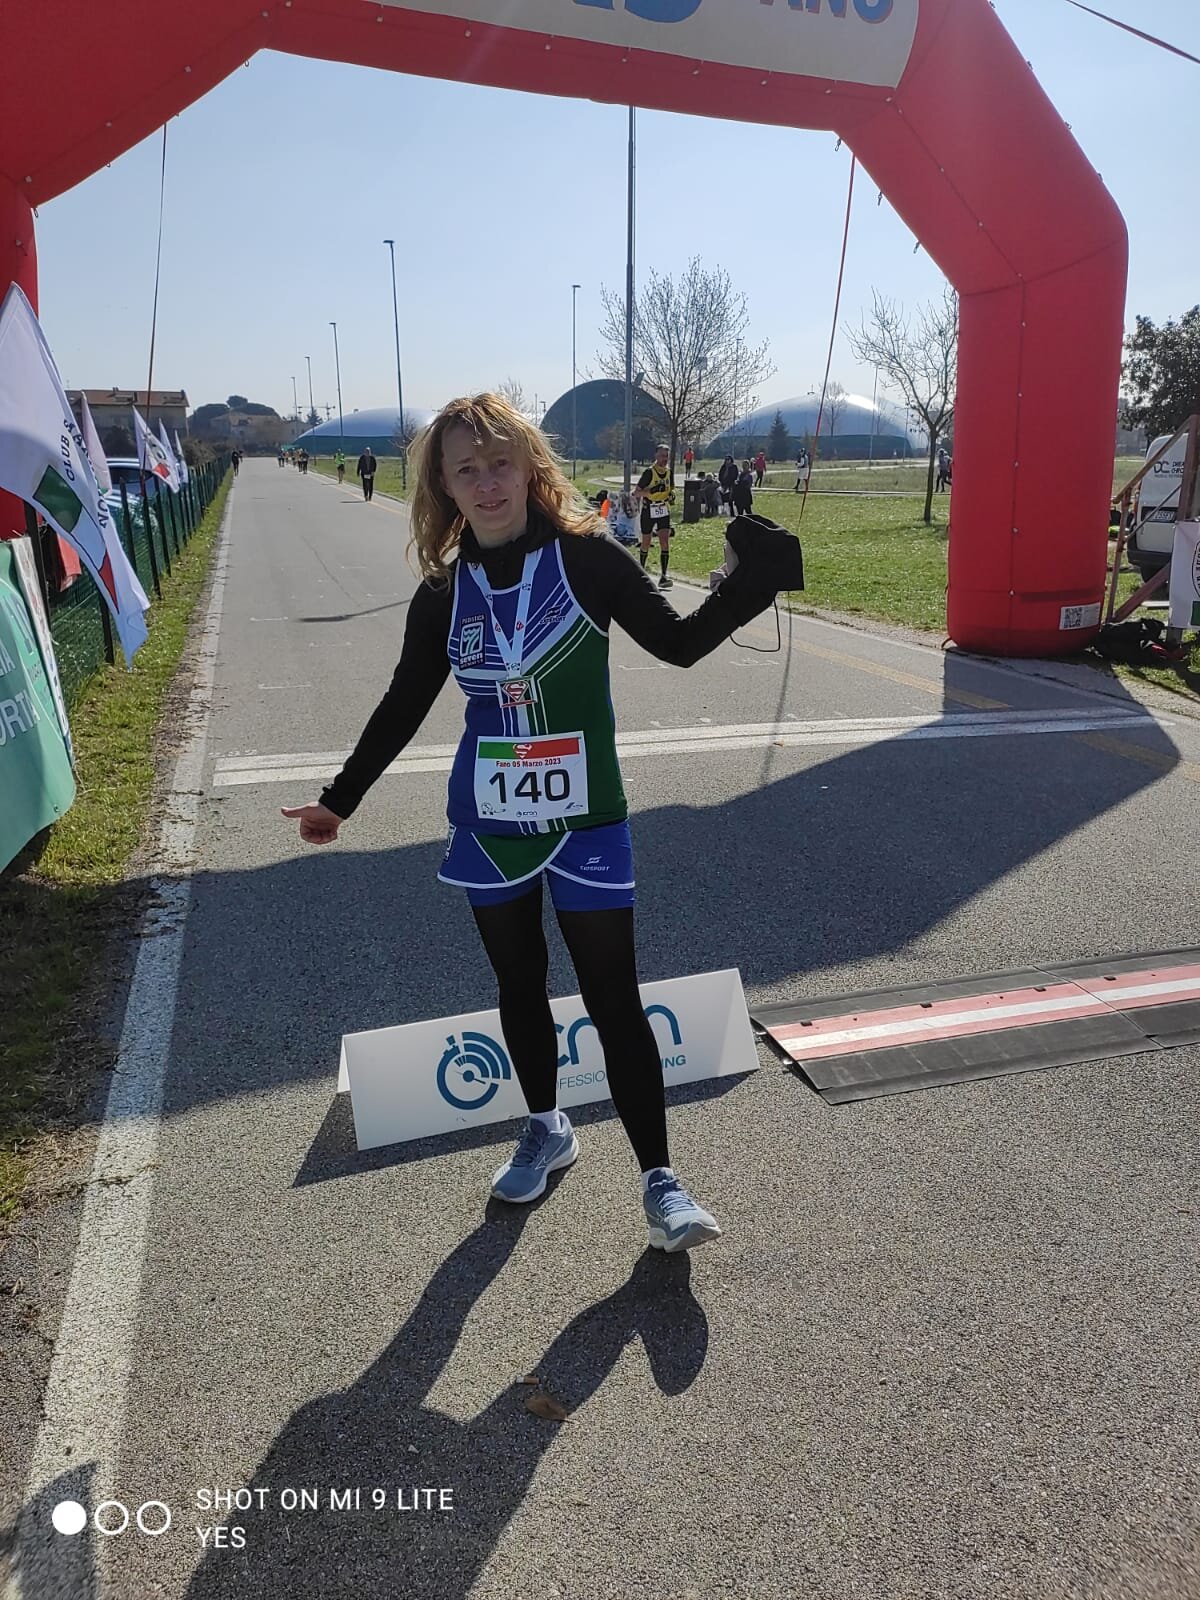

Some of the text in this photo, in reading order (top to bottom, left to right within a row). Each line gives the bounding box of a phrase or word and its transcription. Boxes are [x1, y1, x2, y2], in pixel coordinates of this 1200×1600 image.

[60, 435, 76, 482] CLUB
[522, 760, 543, 768] Marzo
[544, 758, 562, 766] 2023
[489, 769, 571, 804] 140
